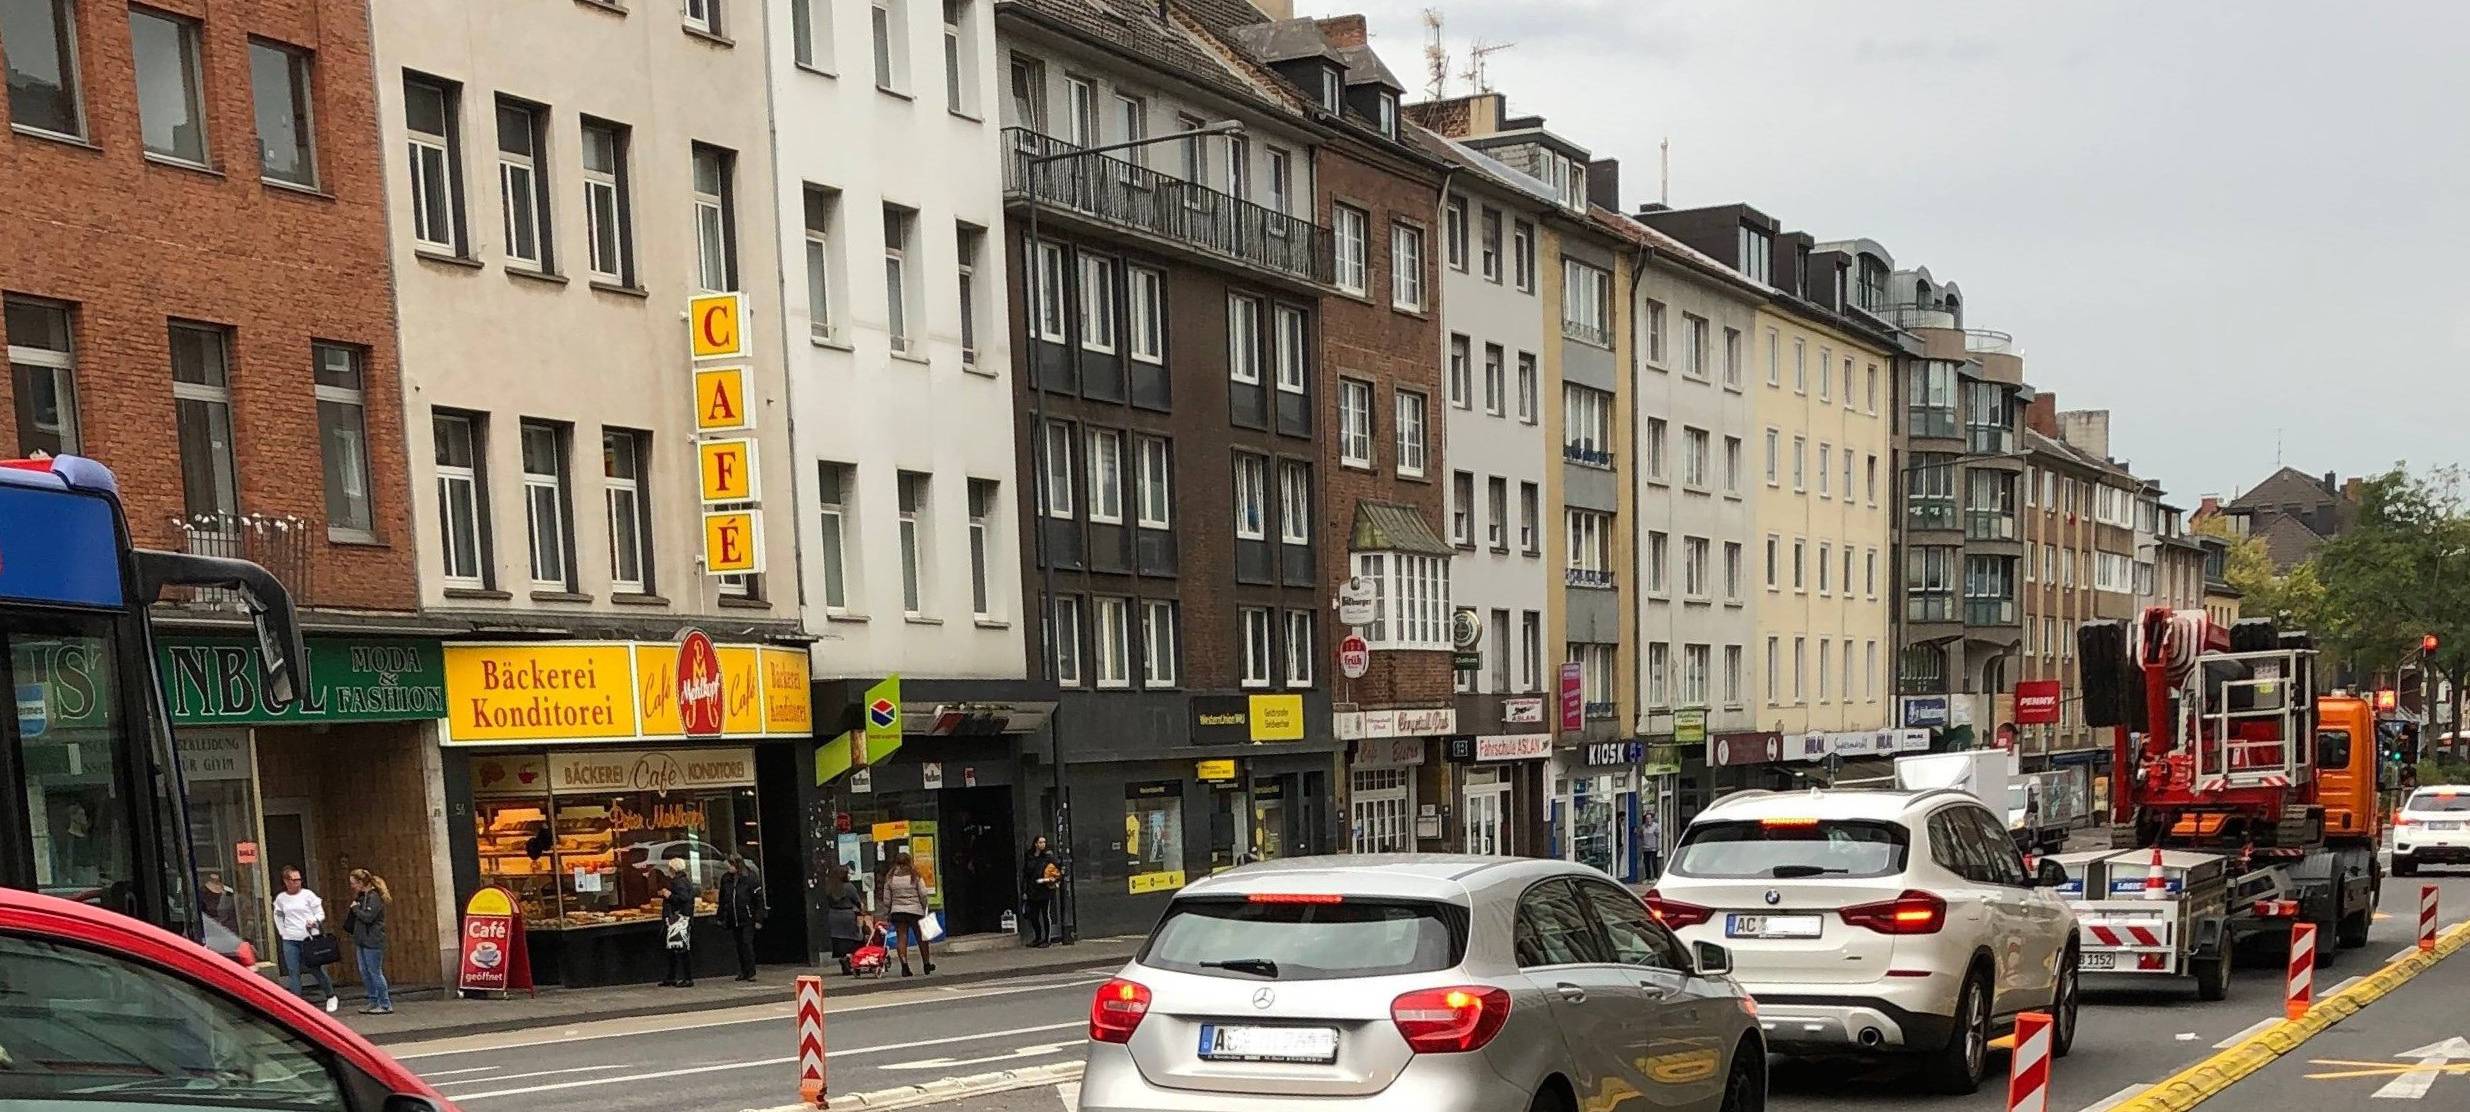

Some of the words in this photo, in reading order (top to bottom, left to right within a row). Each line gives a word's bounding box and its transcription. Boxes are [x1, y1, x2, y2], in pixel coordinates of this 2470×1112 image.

[703, 305, 742, 564] CAFÉ
[351, 646, 423, 673] MODA
[378, 672, 399, 686] &
[481, 658, 597, 690] Bäckerei
[336, 685, 444, 713] FASHION
[471, 694, 614, 728] Konditorei
[1588, 743, 1625, 766] KIOSK
[564, 761, 624, 785] BÄCKEREI
[633, 760, 678, 793] Café
[687, 760, 745, 780] KONDITOREI
[468, 921, 506, 939] Café
[2086, 952, 2113, 966] 1152
[465, 970, 504, 984] geöffnet
